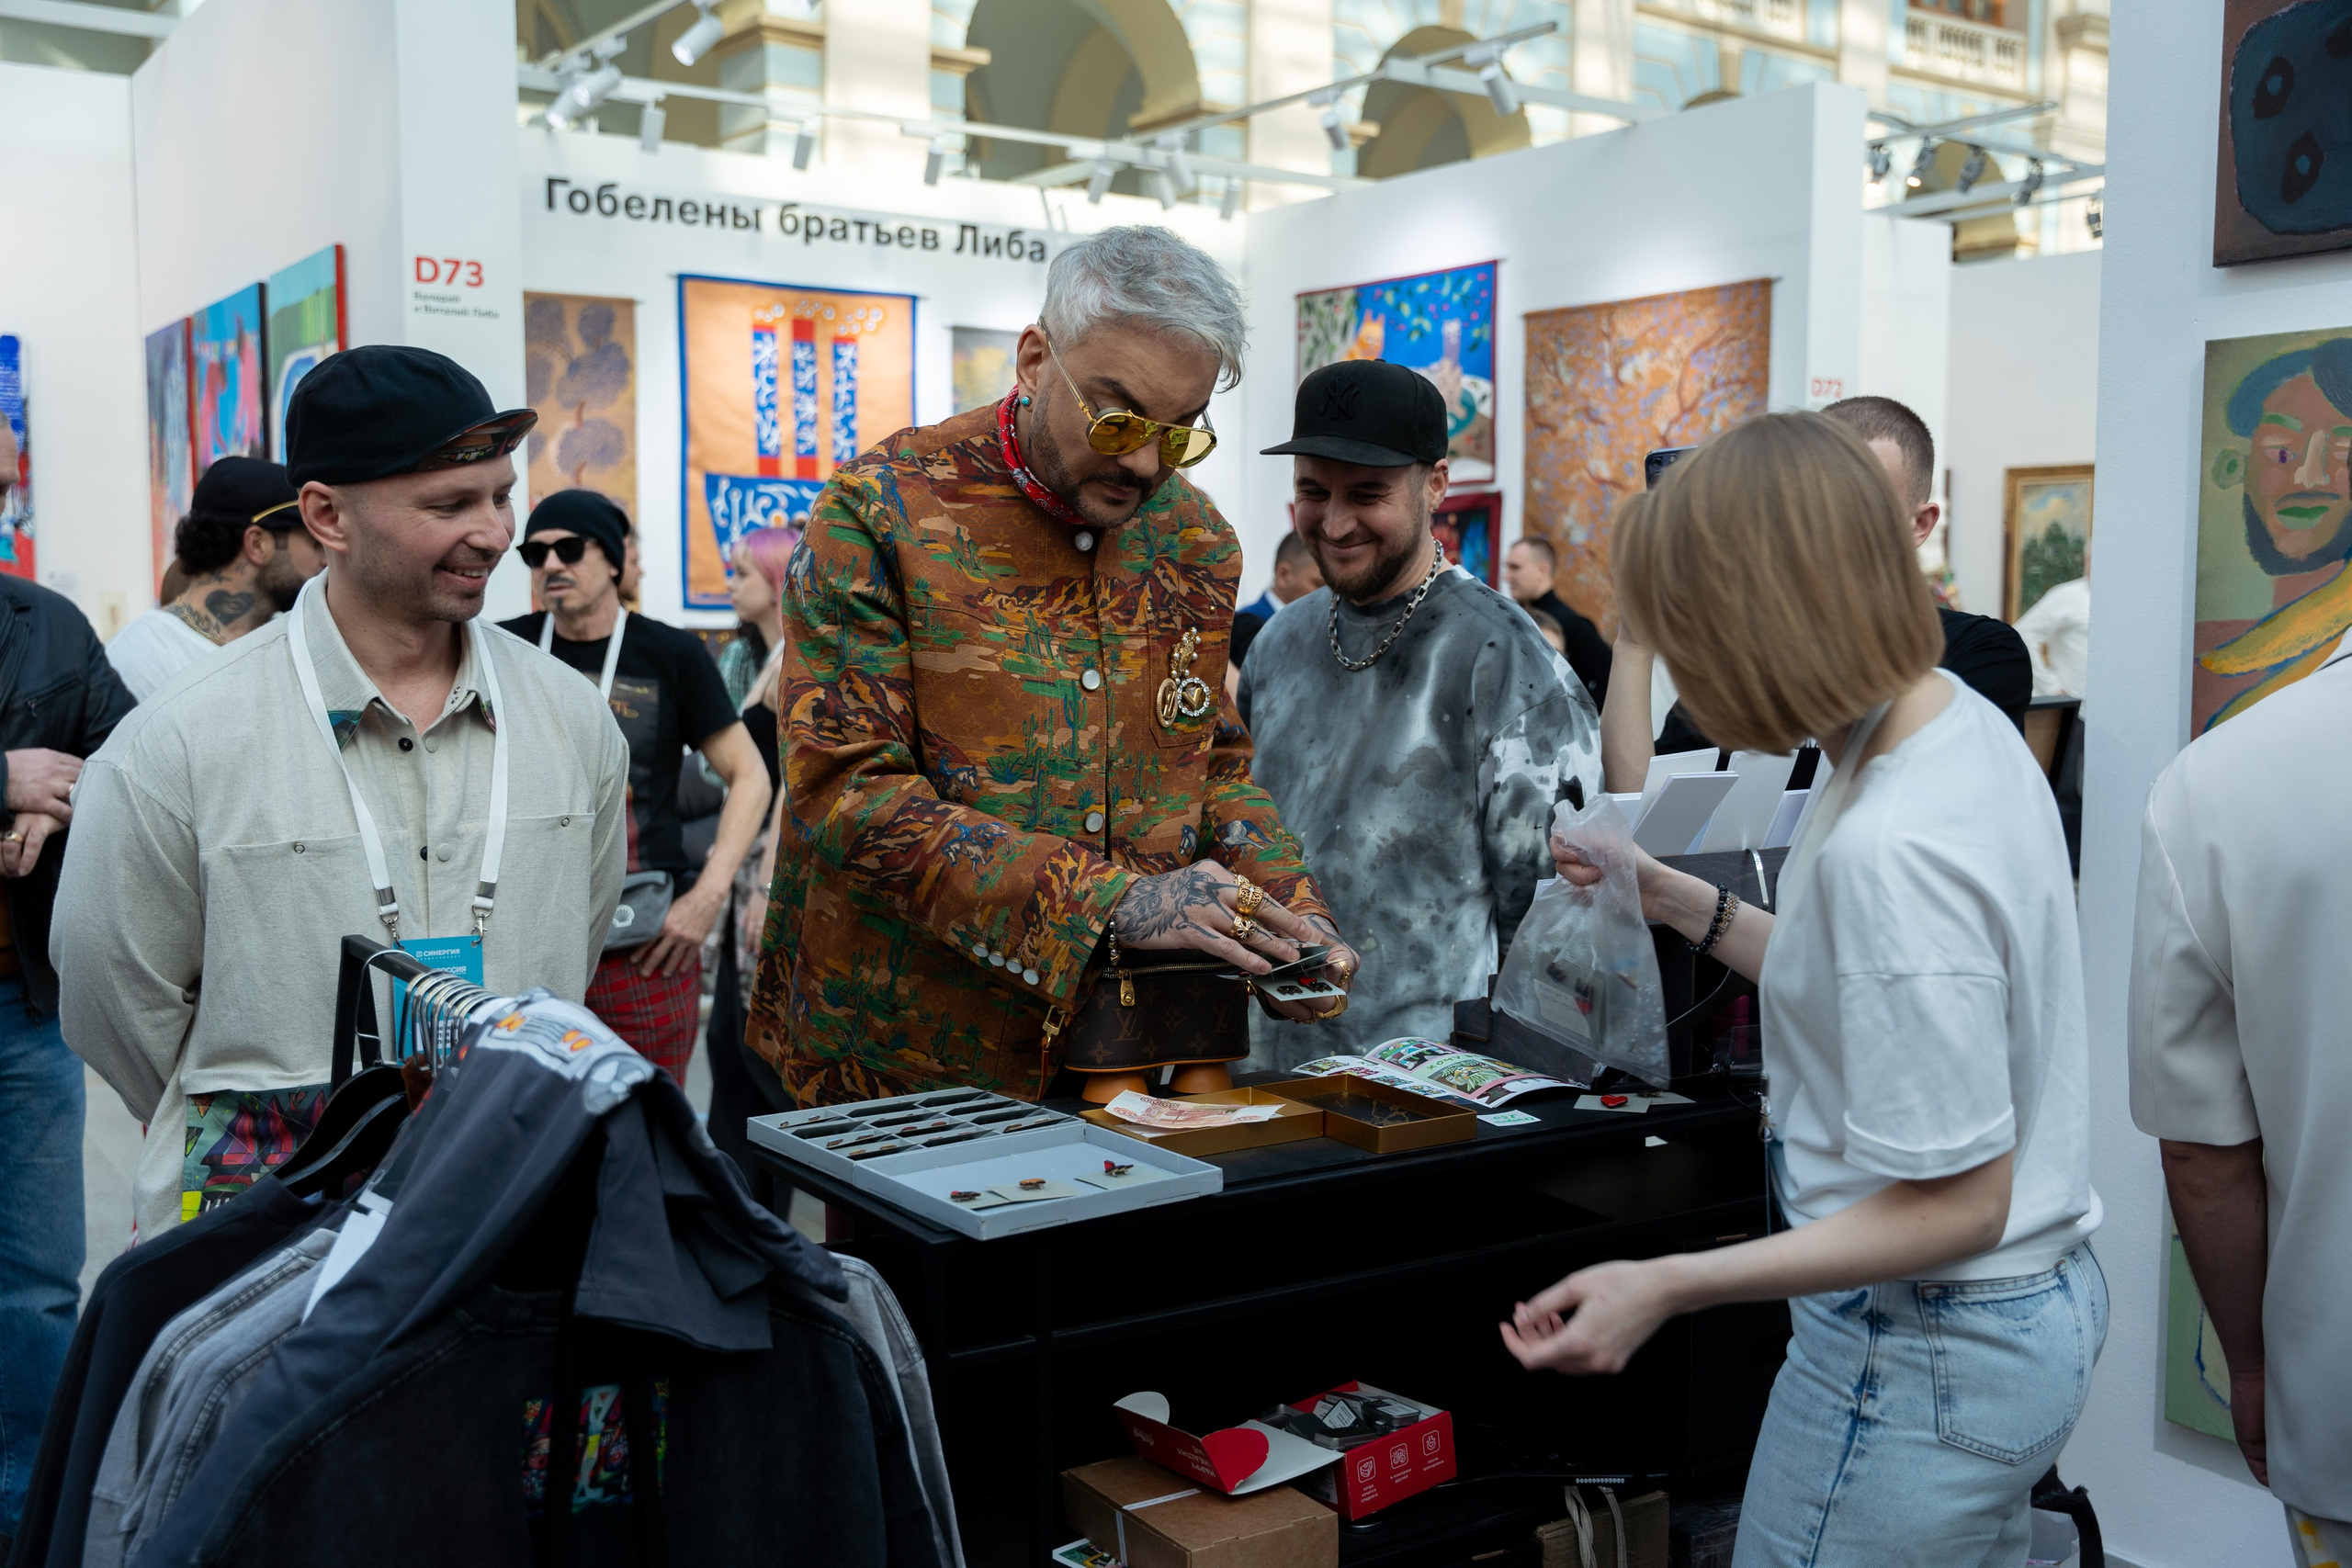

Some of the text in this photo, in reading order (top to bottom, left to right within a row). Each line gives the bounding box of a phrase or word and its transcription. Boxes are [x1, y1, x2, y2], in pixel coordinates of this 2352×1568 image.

[545, 178, 1047, 264] Гобелены братьев Либа
[415, 255, 485, 288] D73
[424, 948, 460, 957] СИНЕРГИЯ
[1176, 1447, 1211, 1467] HEALTHY
[1191, 1461, 1216, 1478] HAPPY
